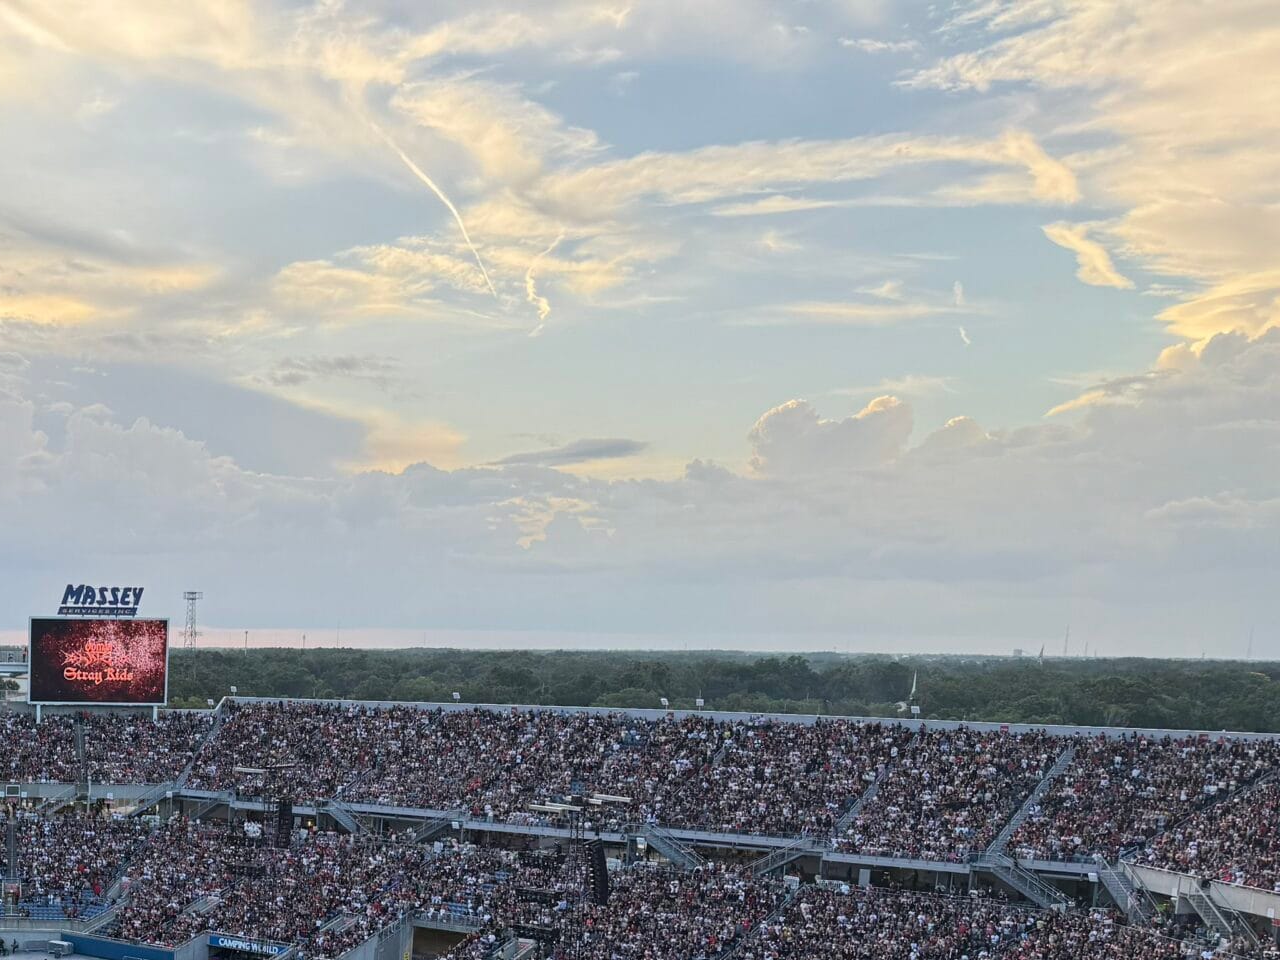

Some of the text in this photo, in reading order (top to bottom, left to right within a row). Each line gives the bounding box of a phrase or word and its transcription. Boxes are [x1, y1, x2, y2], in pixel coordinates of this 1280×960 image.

[61, 584, 144, 606] MASSEY
[63, 666, 134, 685] Stray Kids
[218, 938, 251, 951] CAMPING
